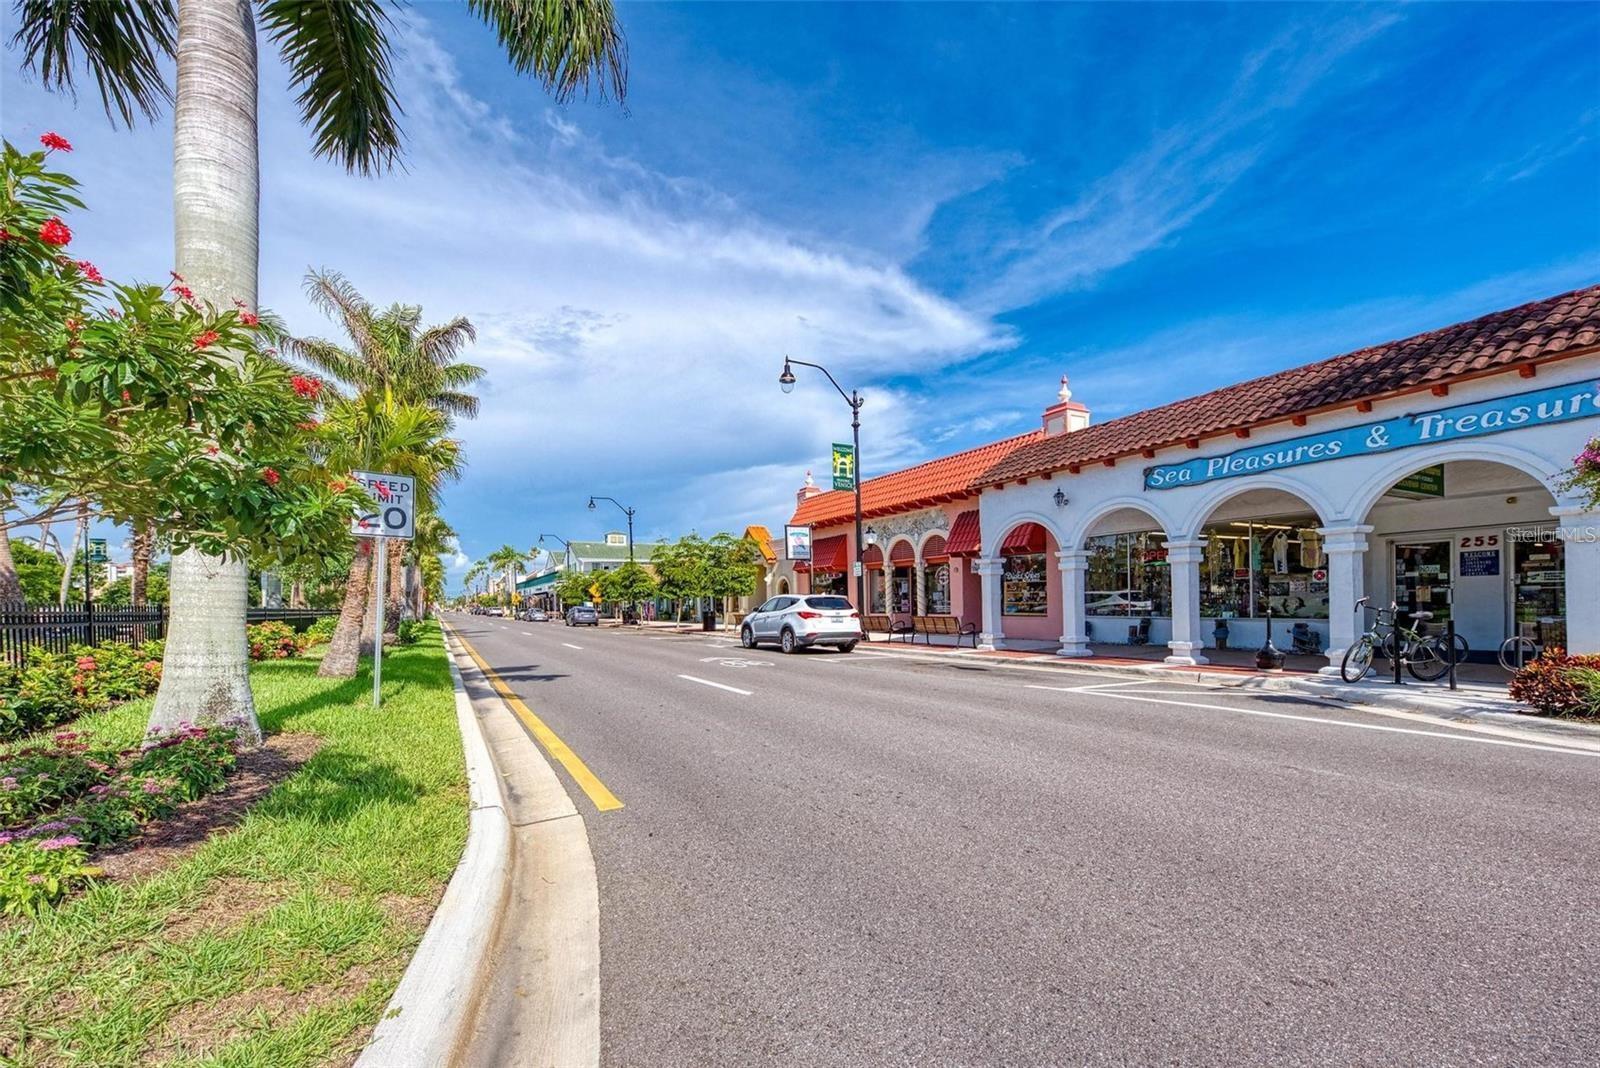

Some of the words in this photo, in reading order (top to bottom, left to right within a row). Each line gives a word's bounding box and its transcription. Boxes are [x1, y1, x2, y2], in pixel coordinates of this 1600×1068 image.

[1151, 468, 1191, 486] Sea
[1206, 440, 1342, 477] Pleasures
[1365, 425, 1390, 448] &
[372, 492, 404, 504] IMIT
[1460, 534, 1499, 548] 255
